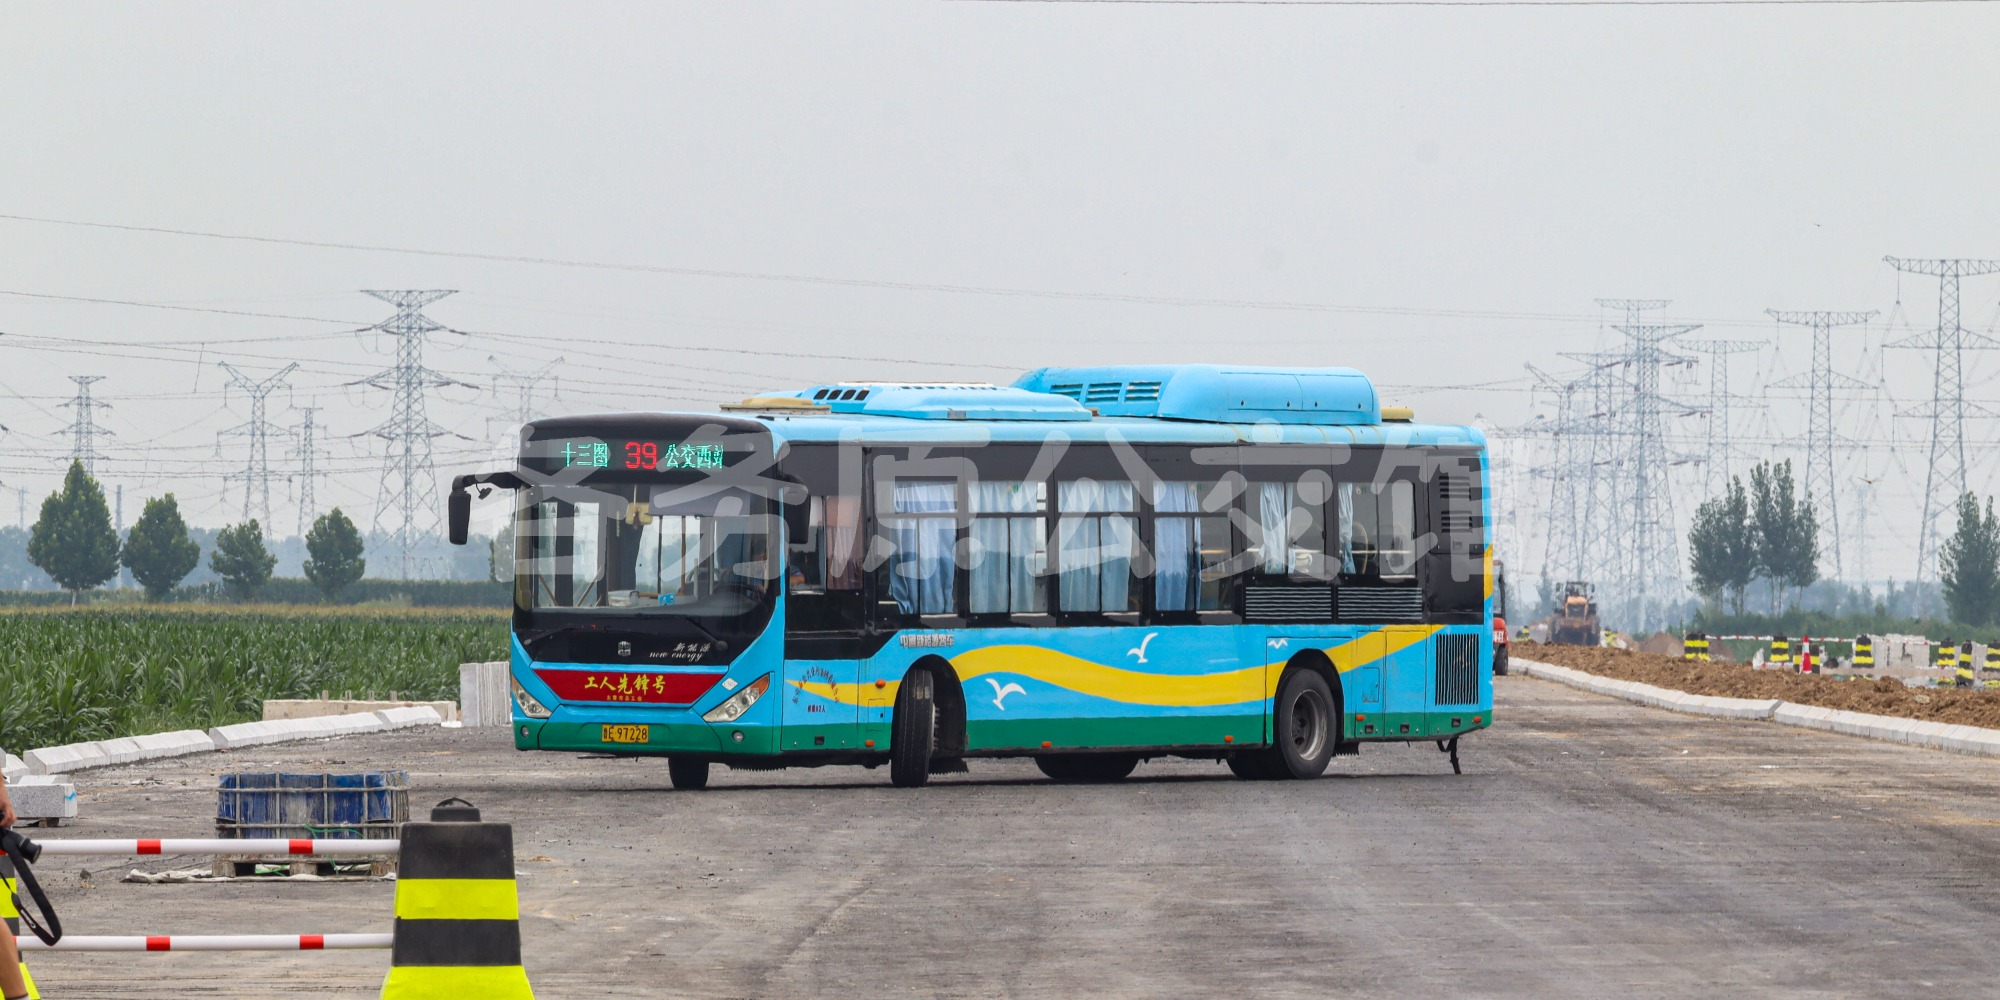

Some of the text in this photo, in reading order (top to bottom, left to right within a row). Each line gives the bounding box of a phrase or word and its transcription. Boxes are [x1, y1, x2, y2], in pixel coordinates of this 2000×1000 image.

[560, 441, 724, 469] 十三图 39 公交西站
[649, 651, 704, 662] new energy
[584, 673, 666, 696] 工人先锋号
